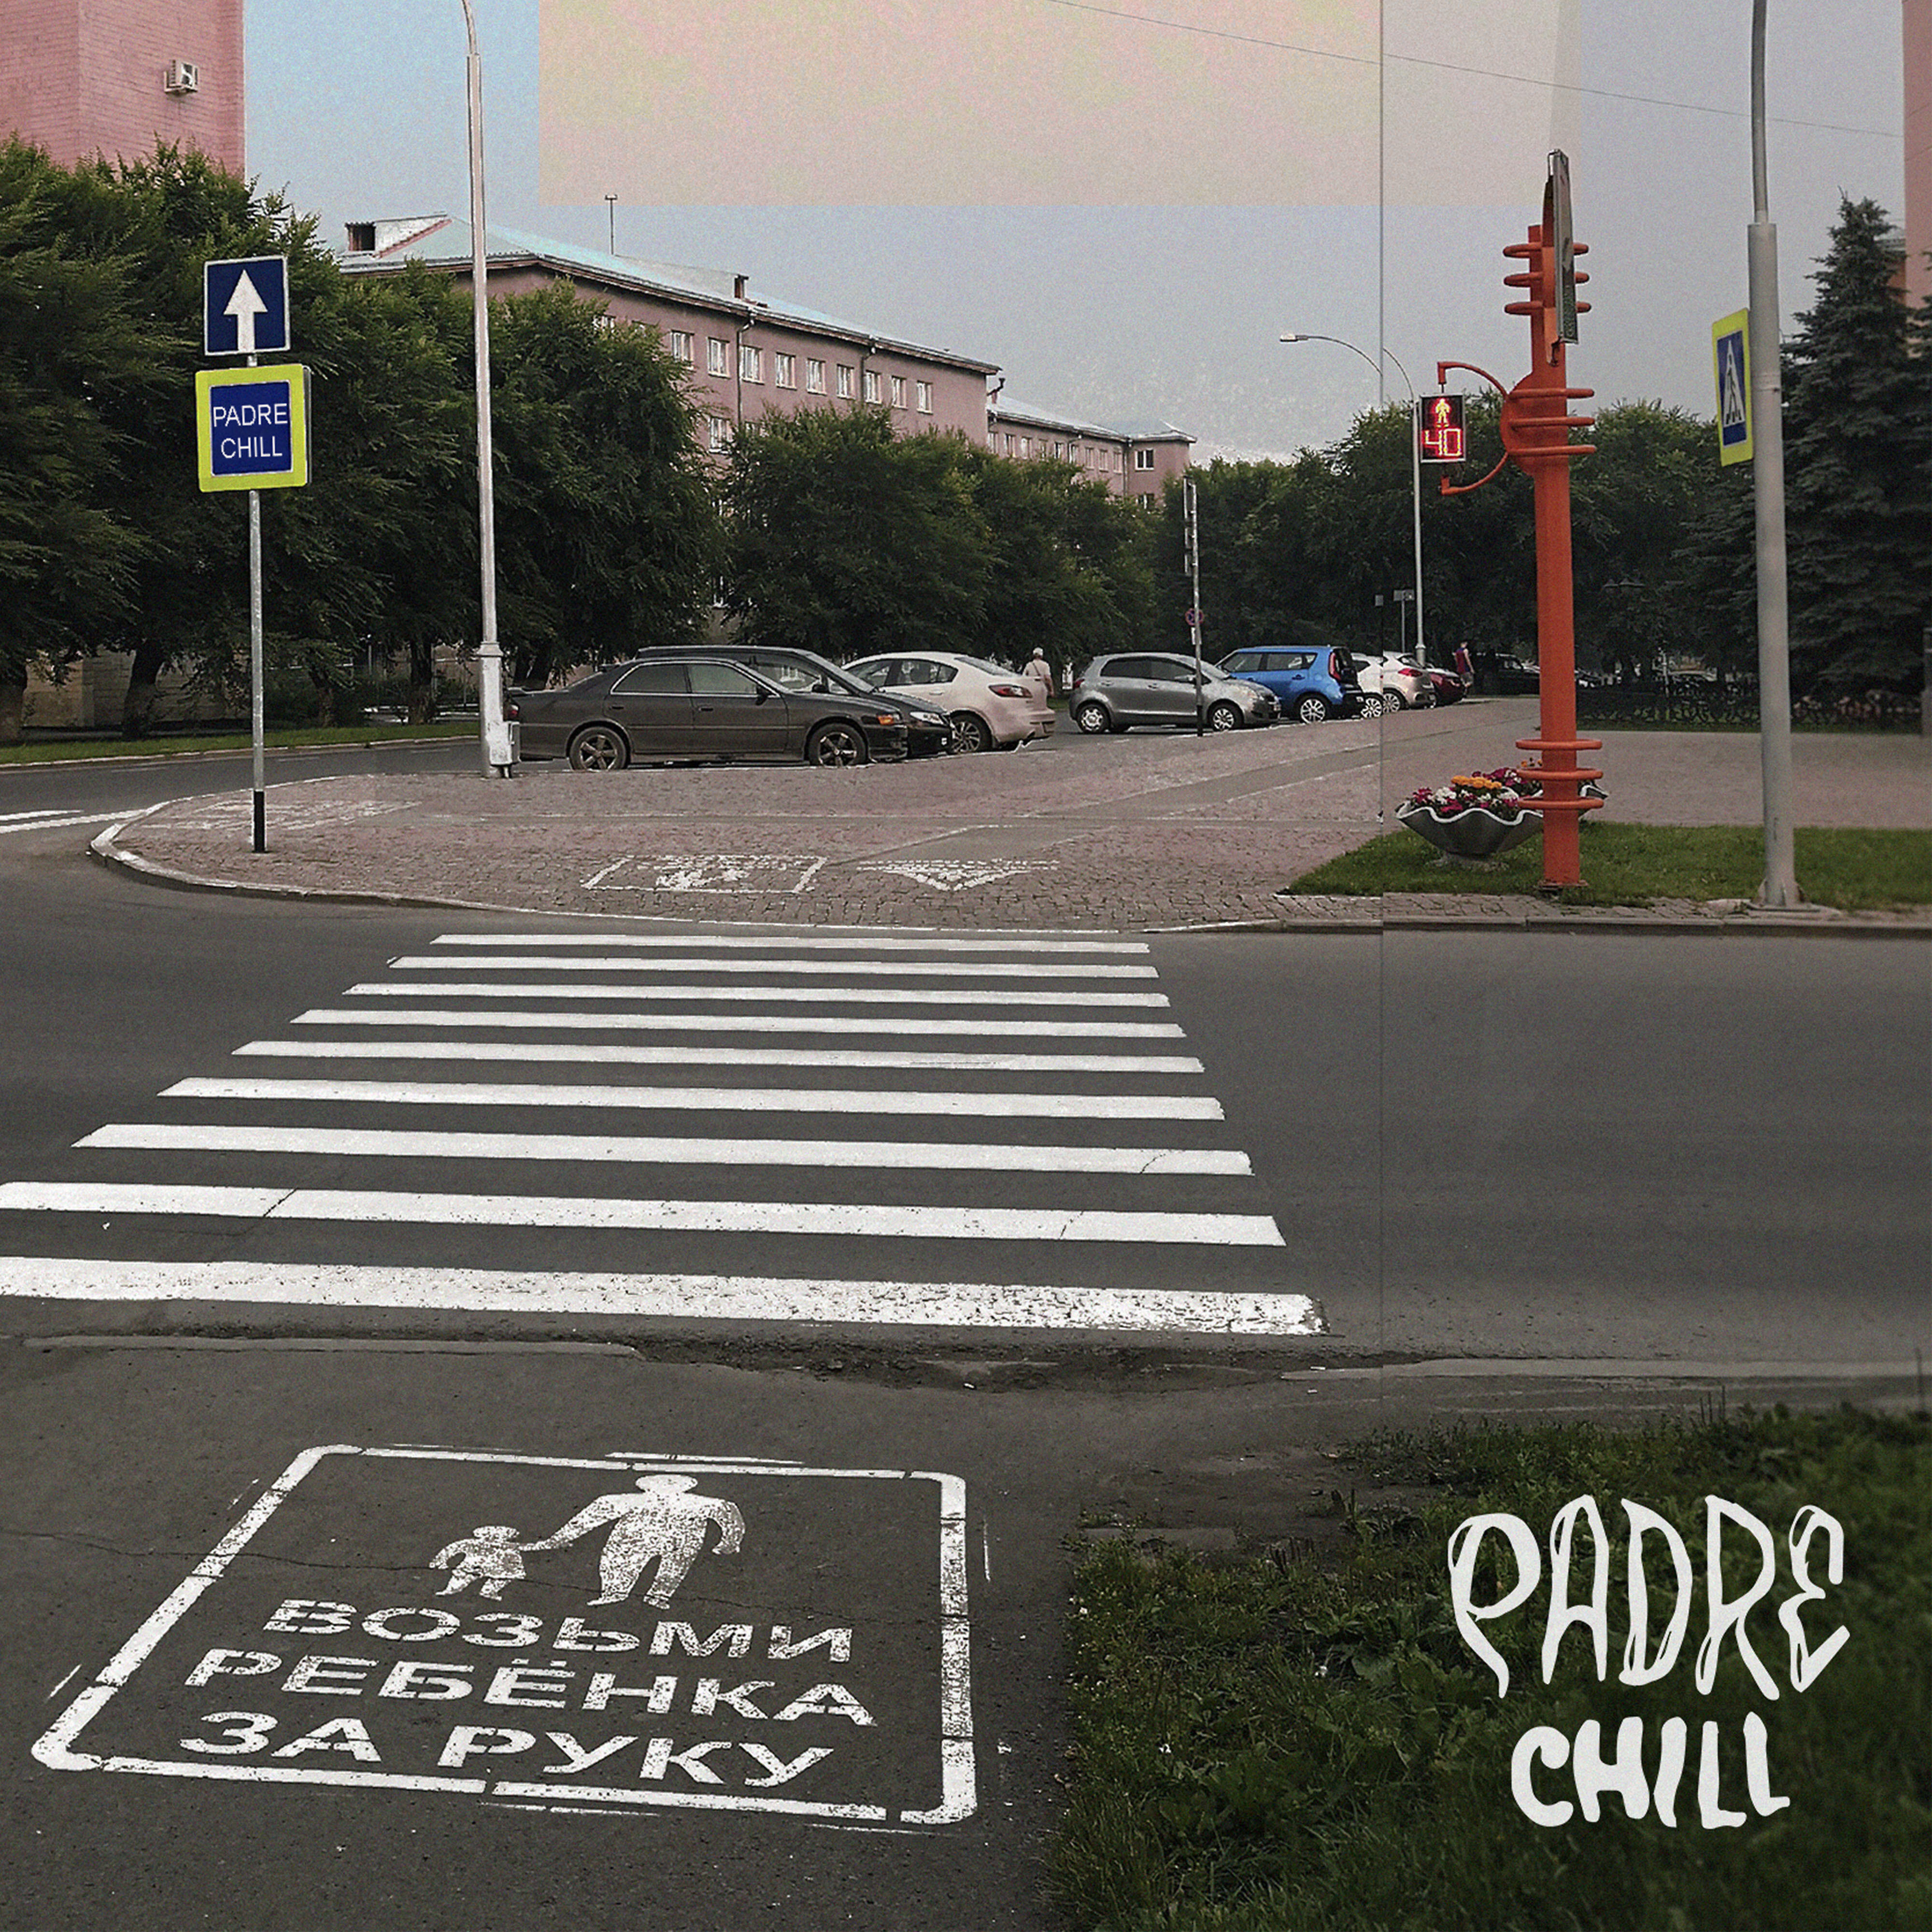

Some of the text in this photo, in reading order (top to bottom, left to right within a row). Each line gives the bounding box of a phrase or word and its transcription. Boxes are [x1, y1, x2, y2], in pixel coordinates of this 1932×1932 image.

[213, 403, 288, 427] PADRE
[221, 436, 283, 458] CHILL
[1424, 428, 1462, 456] 40
[263, 1599, 853, 1662] ВОЗЬМИ
[184, 1648, 877, 1727] РЕБЁНКА
[180, 1711, 834, 1788] ЗА РУКУ
